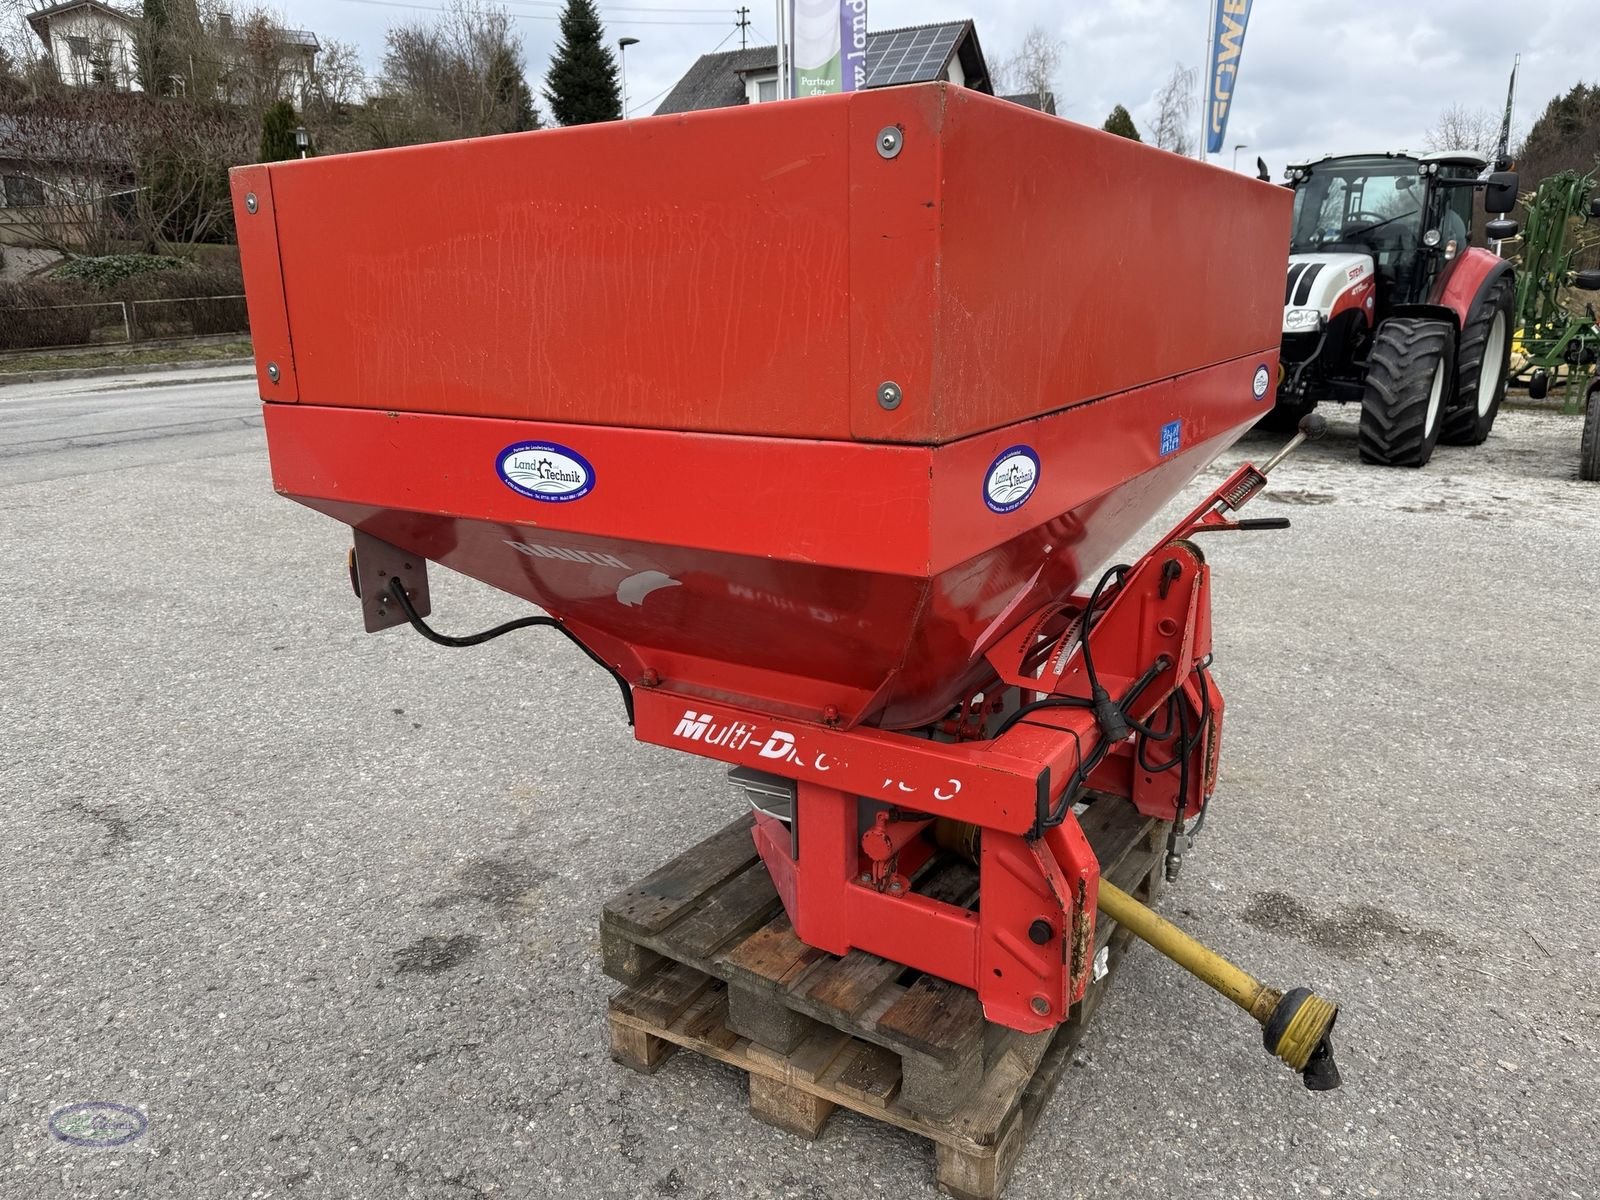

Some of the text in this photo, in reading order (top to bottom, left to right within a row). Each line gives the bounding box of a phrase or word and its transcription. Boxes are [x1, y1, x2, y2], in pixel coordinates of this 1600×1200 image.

[846, 0, 866, 92] w.land
[801, 76, 835, 86] Partner
[810, 87, 826, 96] der
[514, 457, 536, 471] Land
[544, 468, 581, 483] Technik
